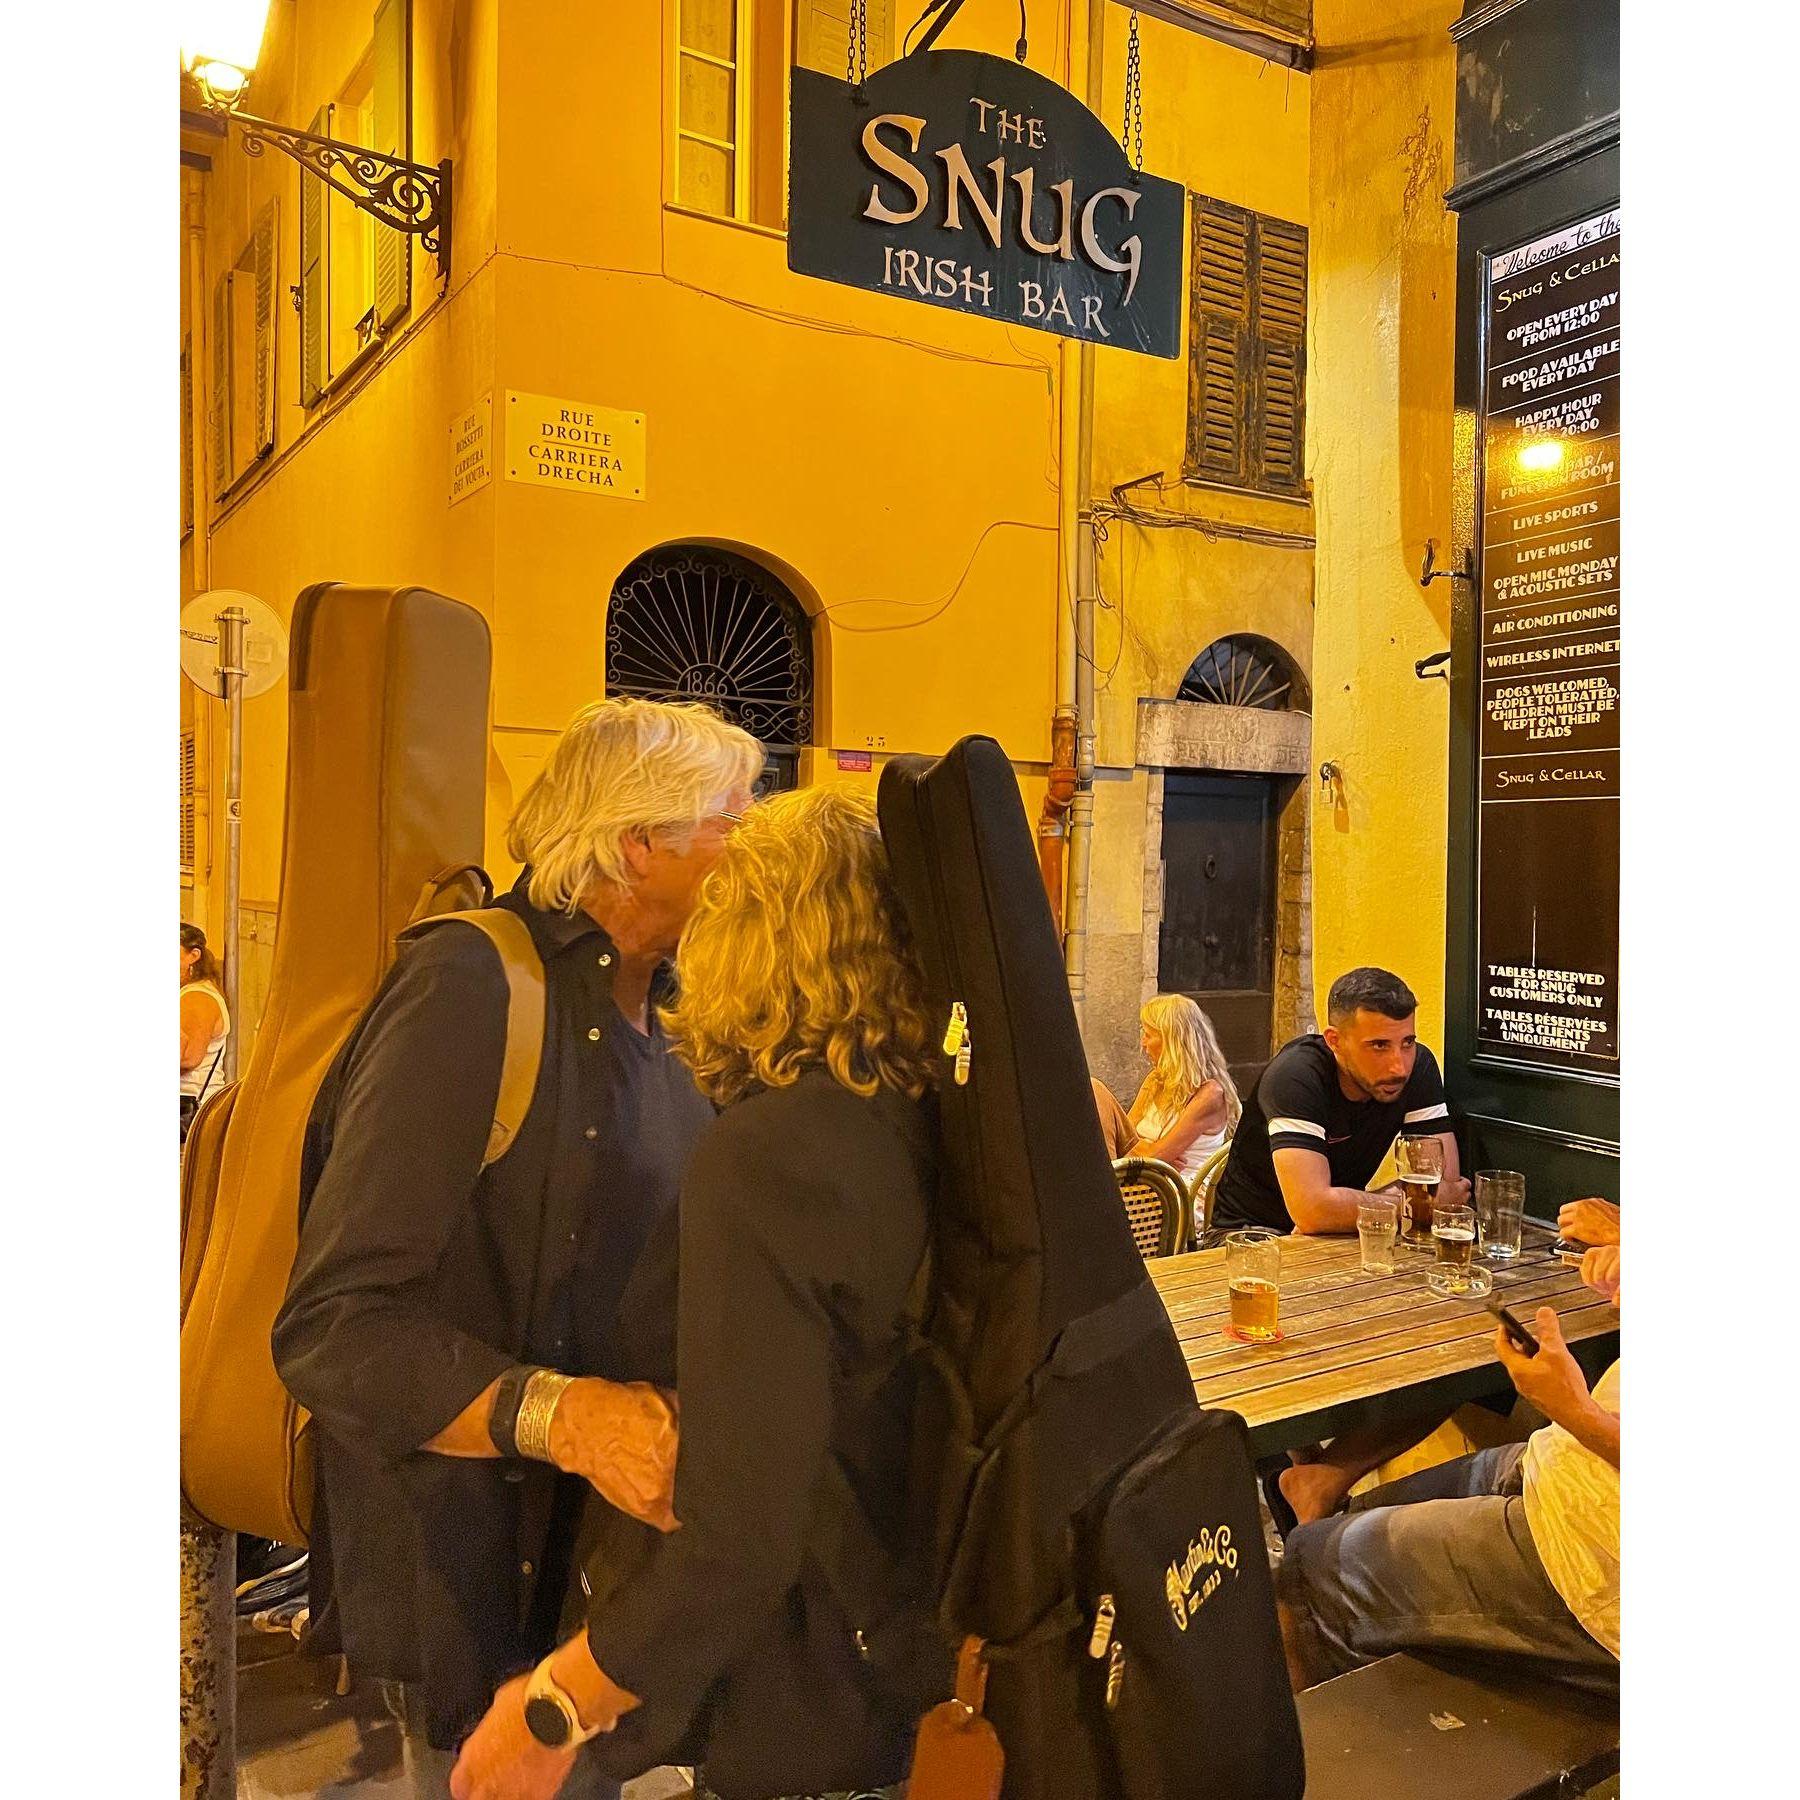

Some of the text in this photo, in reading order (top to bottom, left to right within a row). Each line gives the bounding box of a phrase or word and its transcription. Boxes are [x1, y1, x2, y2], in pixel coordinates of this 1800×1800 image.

[969, 97, 1046, 149] THE
[861, 113, 1142, 306] SNUG
[1503, 242, 1569, 275] Welcome
[1571, 225, 1592, 245] to
[1550, 272, 1562, 288] &
[1564, 254, 1620, 280] CELLA
[883, 248, 1110, 338] IRISH BAR
[1506, 292, 1618, 341] OPEN EVERY DAY
[1522, 311, 1601, 348] FROM 12:00
[1502, 340, 1620, 389] FOOD AVAILABLE
[1522, 359, 1597, 393] EVERY DAY
[464, 414, 476, 432] RUE
[560, 409, 594, 427] RUE
[1515, 393, 1602, 429] HAPPY HOUR
[1522, 407, 1594, 436] EVERY DAY
[541, 423, 612, 446] DROITE
[1560, 418, 1600, 438] 20:00
[528, 445, 622, 472] CARRIERA
[538, 464, 614, 487] DRECHA
[1570, 461, 1614, 483] ROOM
[1513, 501, 1599, 530] LIVE SPORTS
[1516, 538, 1593, 563] LIVE MUSIC
[1494, 555, 1619, 590] OPEN MIC MONDAY
[1497, 569, 1614, 600] & ACOUSTIC SETS
[1493, 604, 1618, 635] AIR CONDITIONING
[1486, 639, 1620, 668] WIRELESS INTERNET
[685, 671, 728, 697] 1866
[1496, 677, 1610, 699] DOGS WELCOMED,
[1486, 687, 1620, 711] PEOPLE TOLERATED,
[1491, 699, 1615, 721] CHILDREN MUST BE
[1503, 712, 1601, 731] KEPT ON THEIR
[1529, 726, 1572, 739] LEADS
[1539, 769, 1550, 782] &
[1488, 965, 1605, 986] TABLES RESERVED
[1513, 978, 1576, 994] FOR SNUG
[1489, 986, 1604, 1008] CUSTOMERS ONLY
[1485, 1008, 1608, 1033] TABLES RÉSERVÉES
[1509, 1022, 1535, 1034] NOS
[1536, 1024, 1591, 1042] CLIENTS
[1502, 1030, 1589, 1052] UNIQUEMENT
